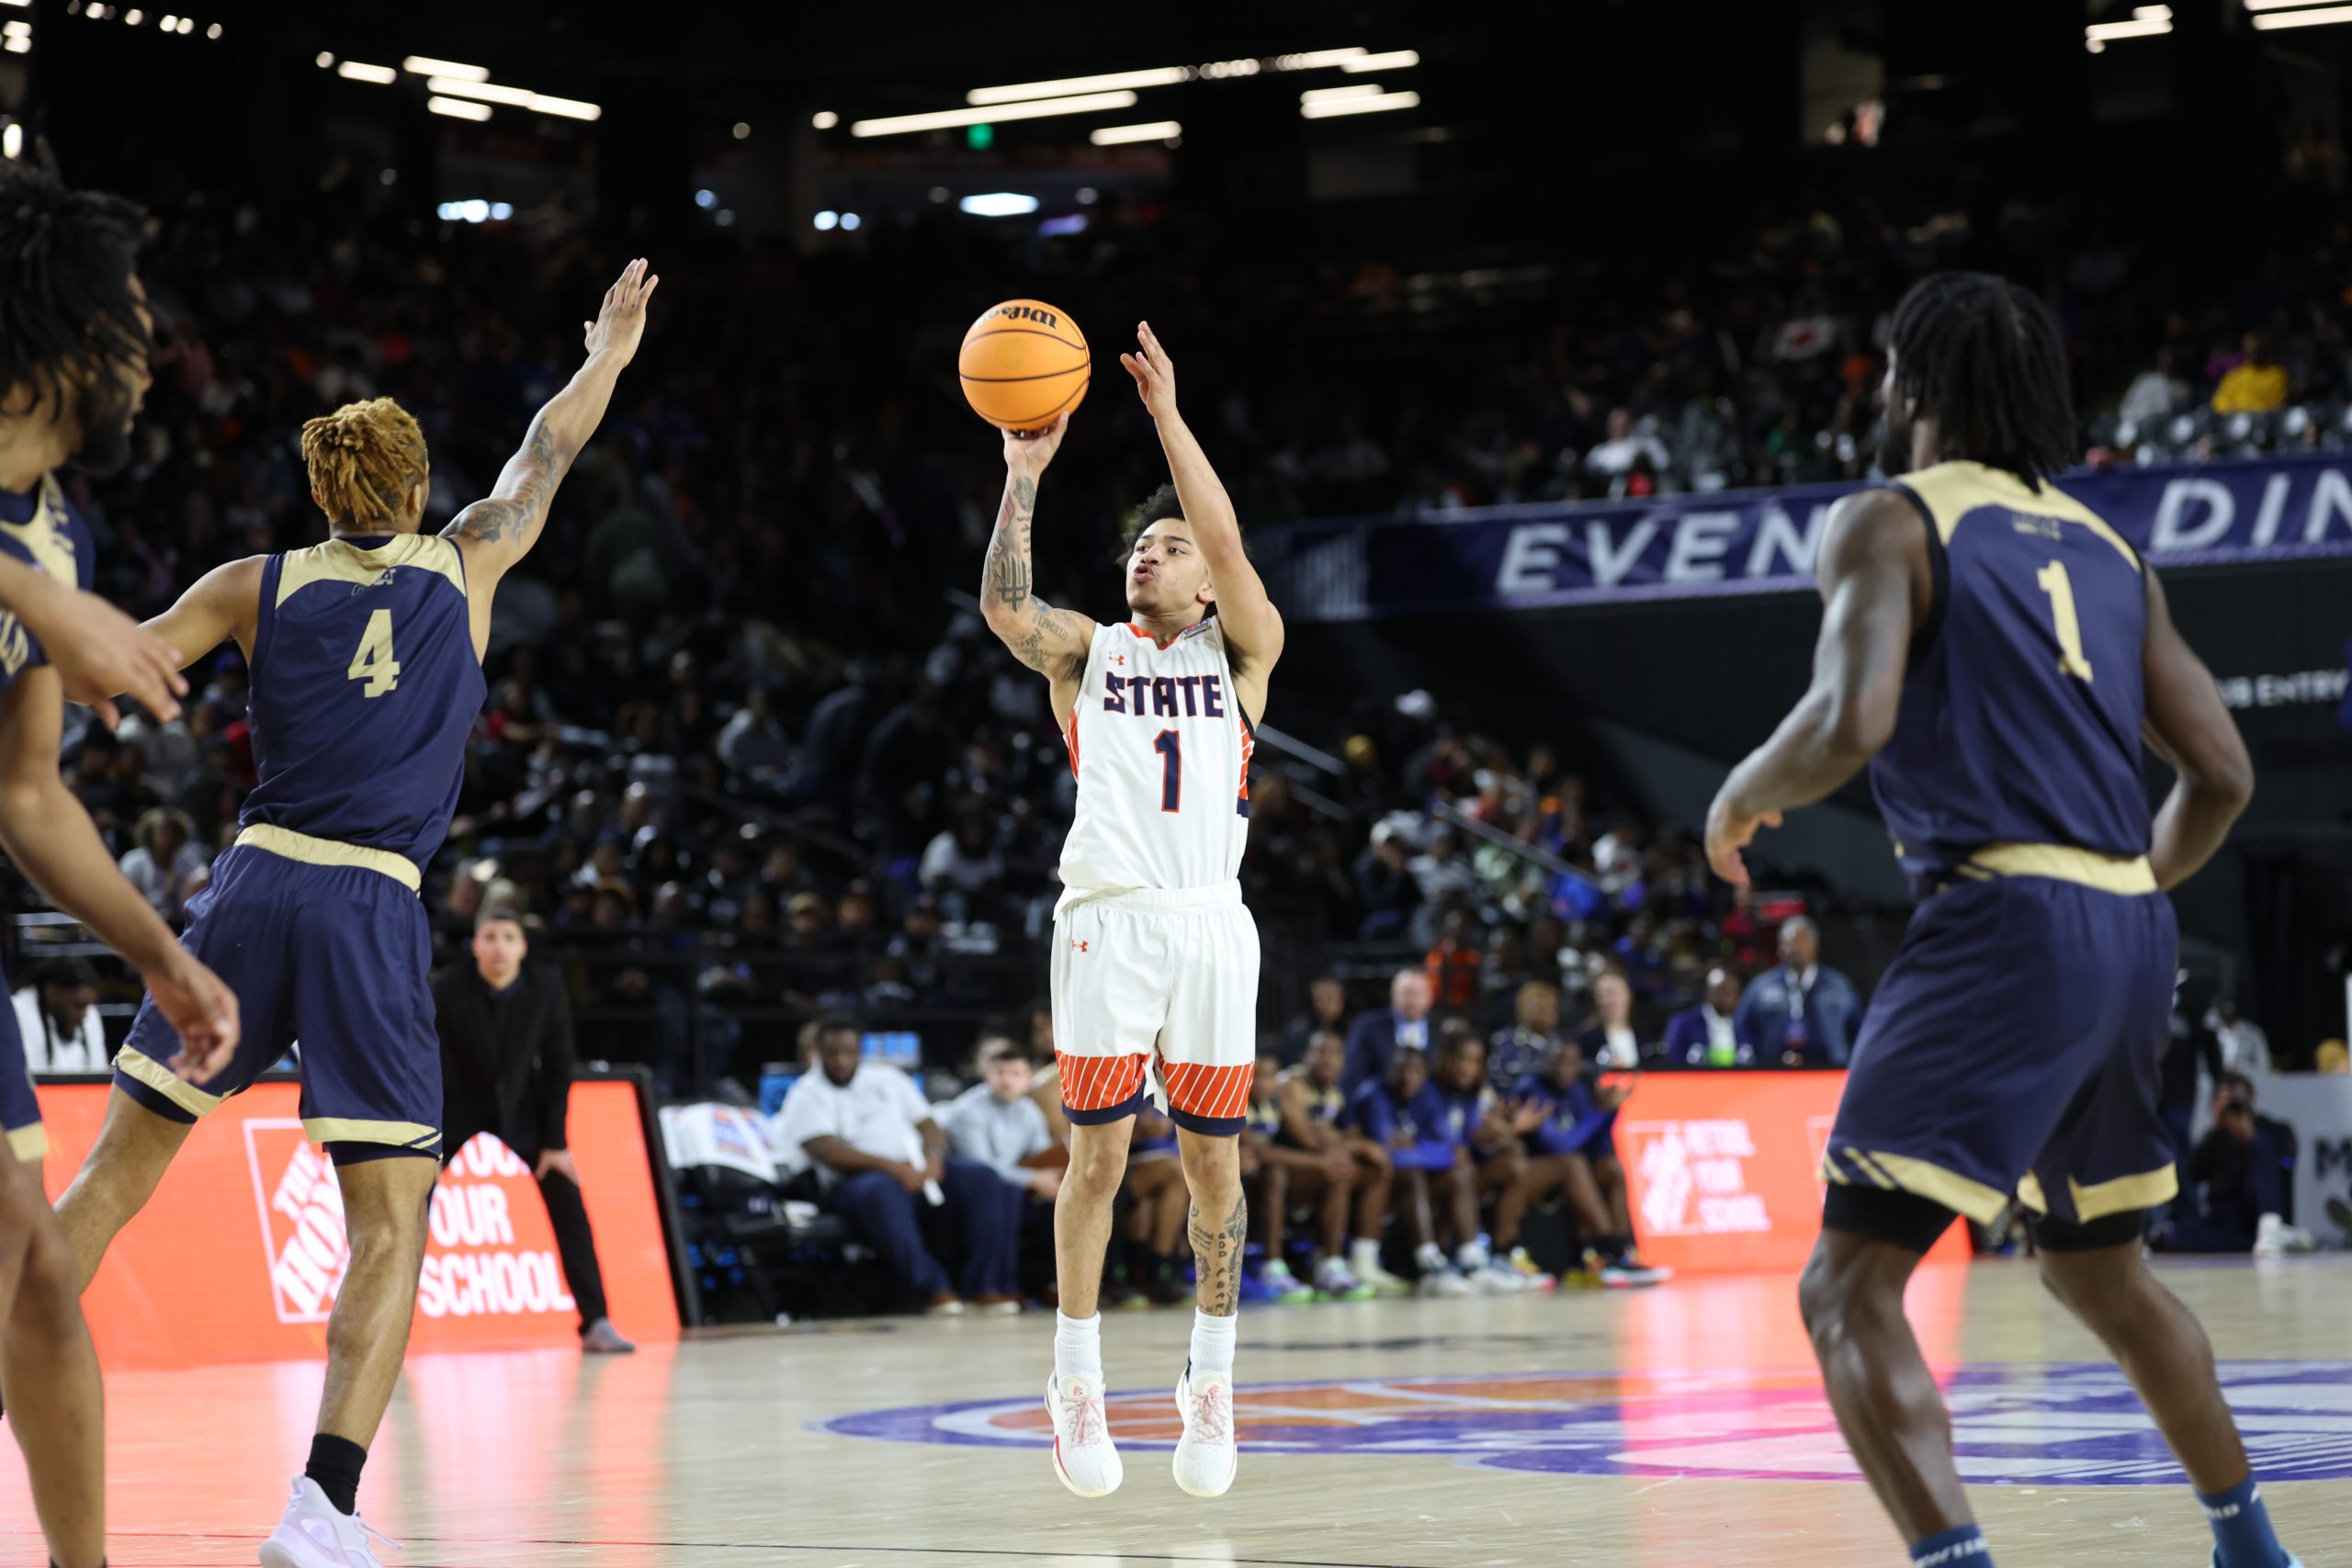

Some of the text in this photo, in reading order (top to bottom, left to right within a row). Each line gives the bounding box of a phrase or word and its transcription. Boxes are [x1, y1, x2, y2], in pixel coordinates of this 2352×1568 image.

[972, 306, 1057, 331] Wils
[347, 608, 401, 698] 4
[2037, 559, 2093, 683] 1
[1103, 671, 1224, 718] STATE
[1153, 728, 1182, 813] 1
[416, 1249, 576, 1318] SCHOOL
